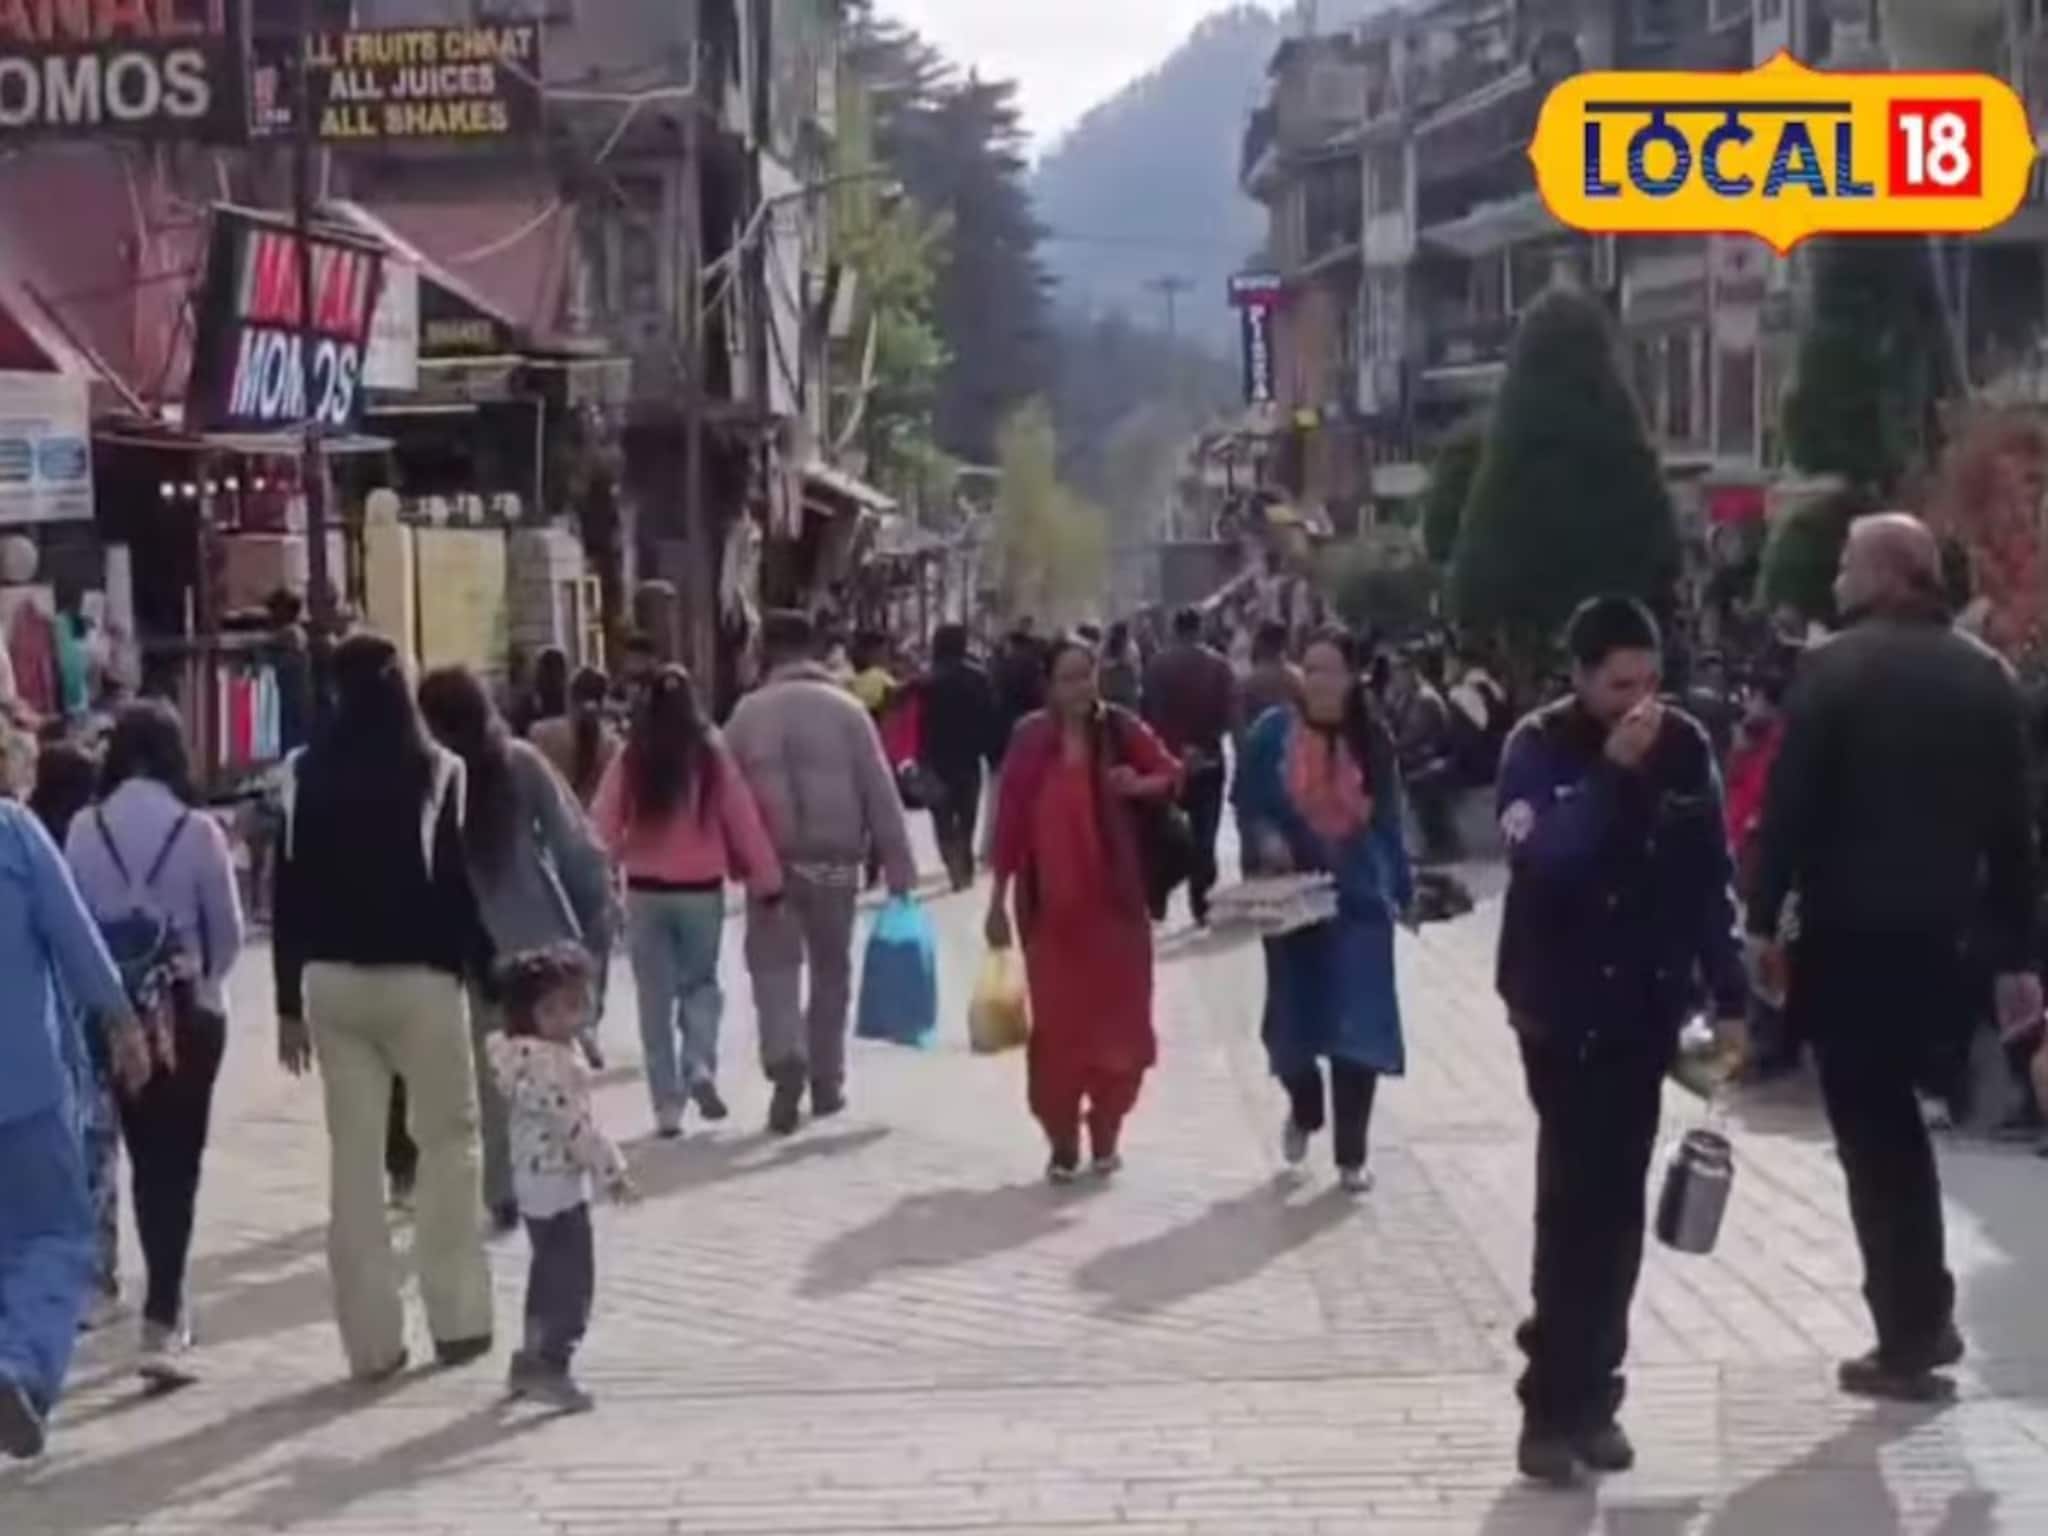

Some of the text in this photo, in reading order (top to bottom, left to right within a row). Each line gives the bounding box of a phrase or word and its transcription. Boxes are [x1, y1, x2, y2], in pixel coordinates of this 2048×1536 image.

[343, 29, 438, 64] FRUITS
[329, 63, 496, 99] ALL JUICES
[319, 106, 377, 136] ALL
[384, 102, 508, 134] SHAKES
